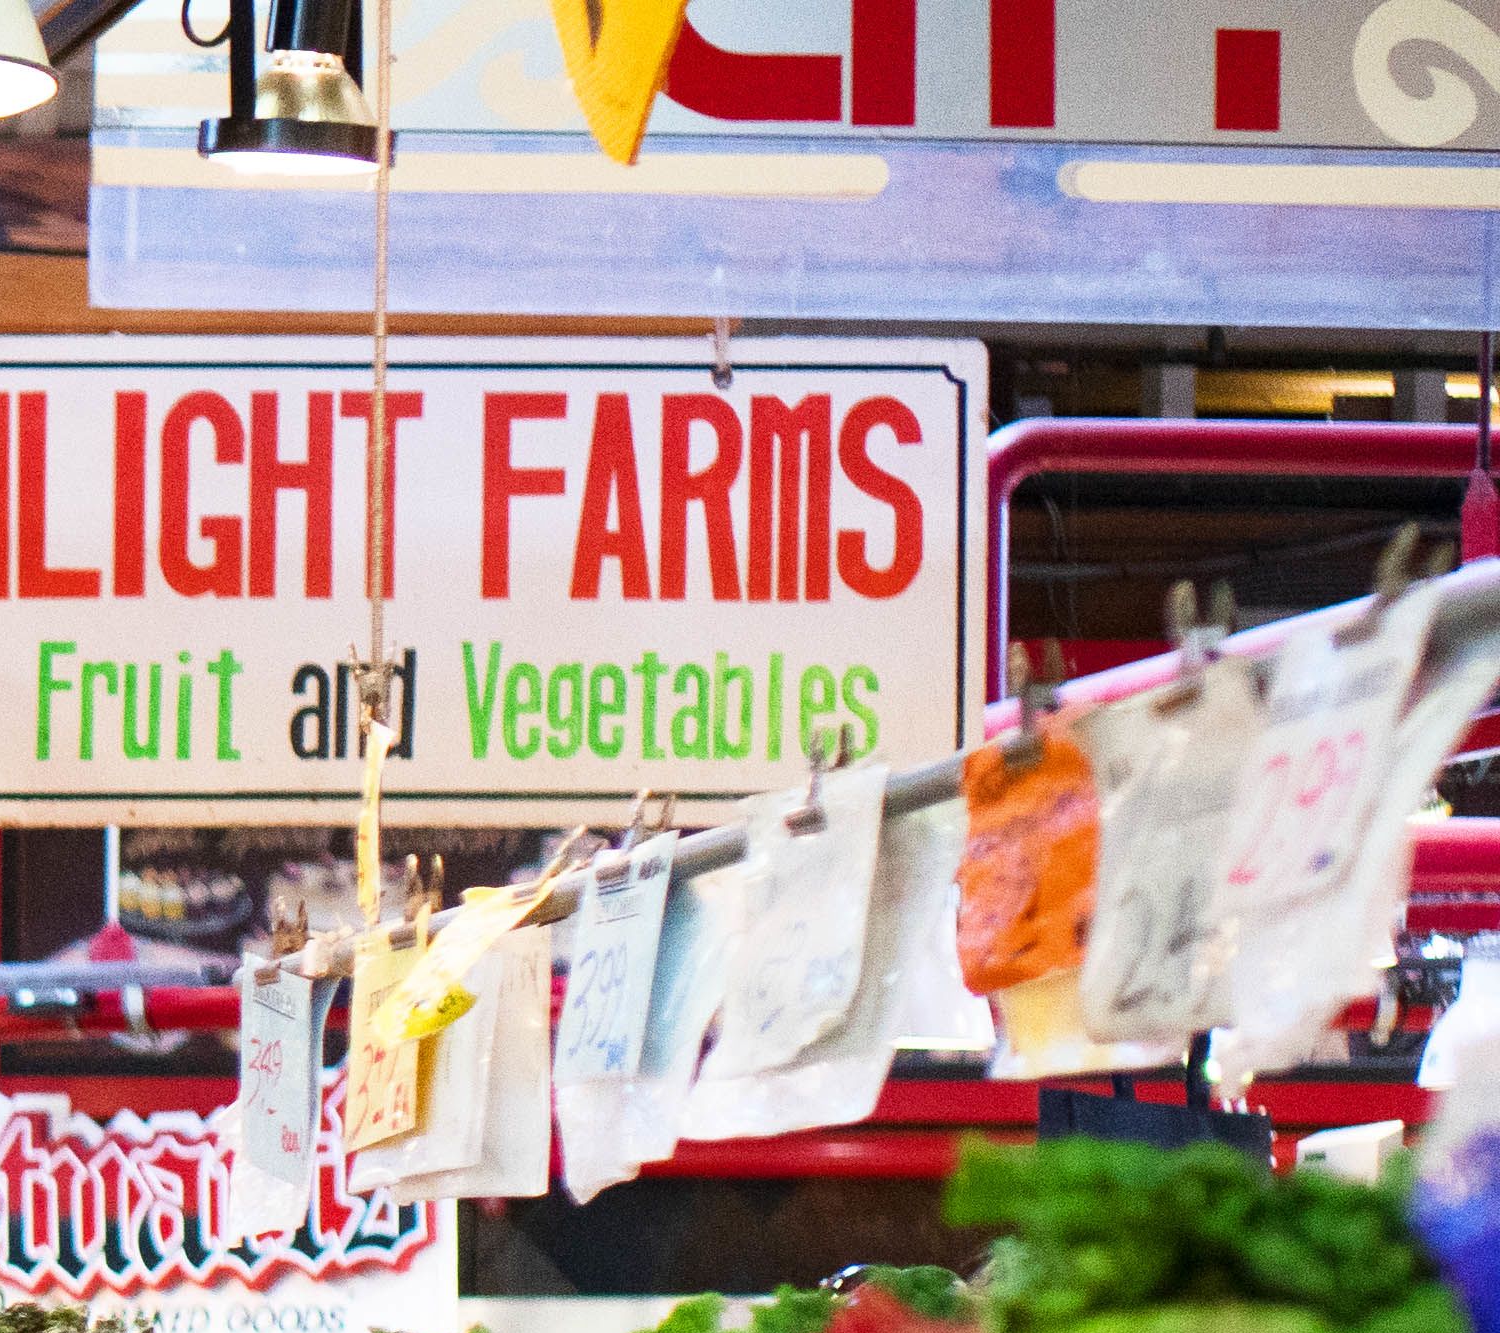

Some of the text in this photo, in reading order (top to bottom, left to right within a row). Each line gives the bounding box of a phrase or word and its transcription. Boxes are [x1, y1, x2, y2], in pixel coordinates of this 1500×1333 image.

[483, 393, 924, 602] FARMS
[38, 642, 245, 763] Fruit
[290, 650, 417, 762] and
[462, 642, 881, 763] Vegetables
